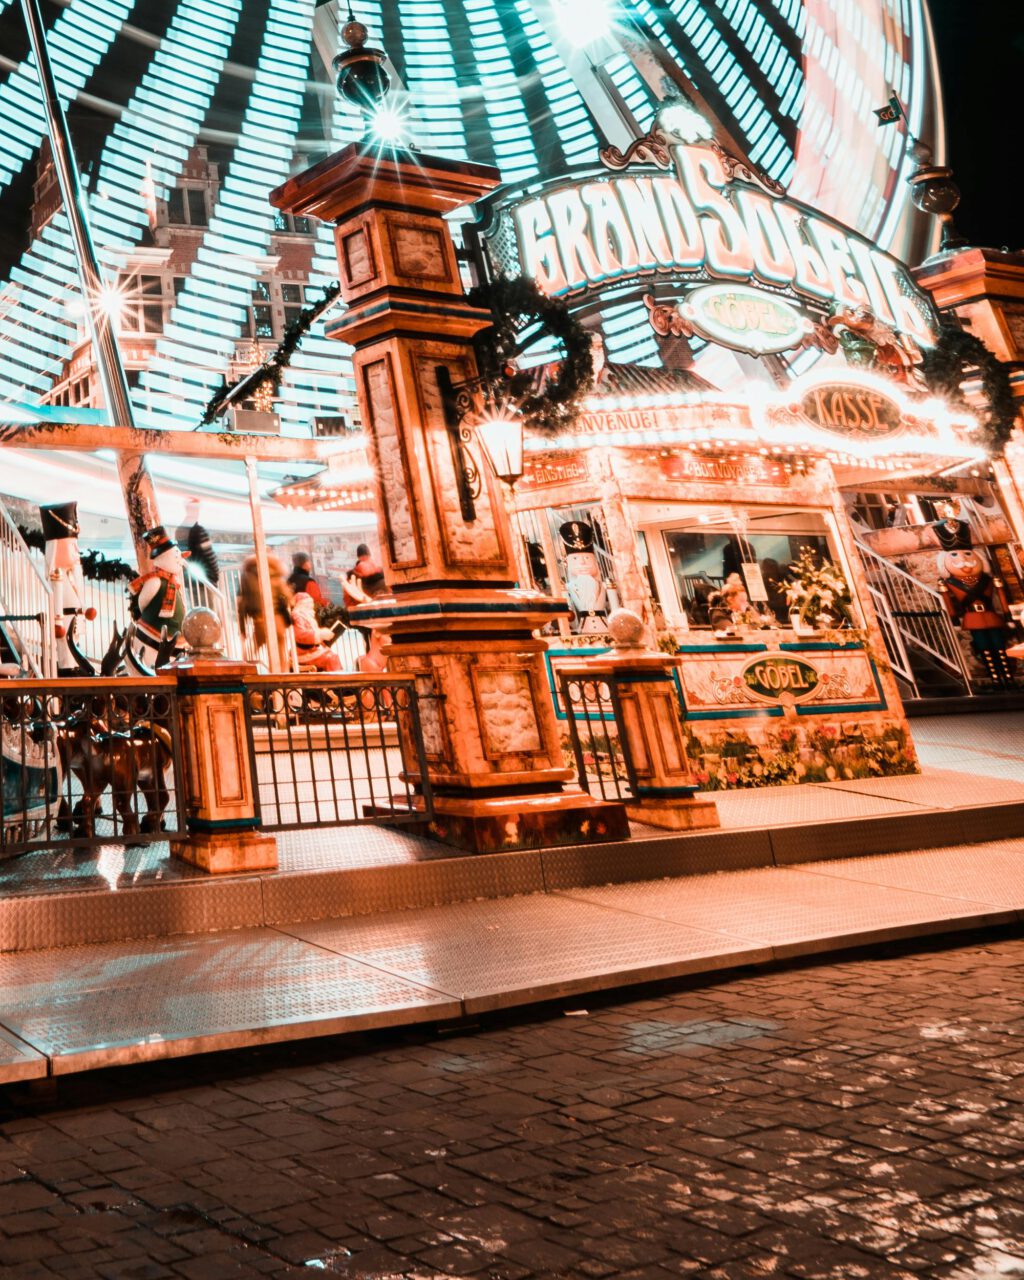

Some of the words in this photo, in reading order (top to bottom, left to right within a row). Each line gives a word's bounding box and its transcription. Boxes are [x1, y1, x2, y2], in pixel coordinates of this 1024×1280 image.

[517, 176, 705, 297] GRAND
[576, 410, 659, 433] ENVENUE!
[813, 390, 889, 431] KASSE
[755, 661, 810, 690] GÖBEL
